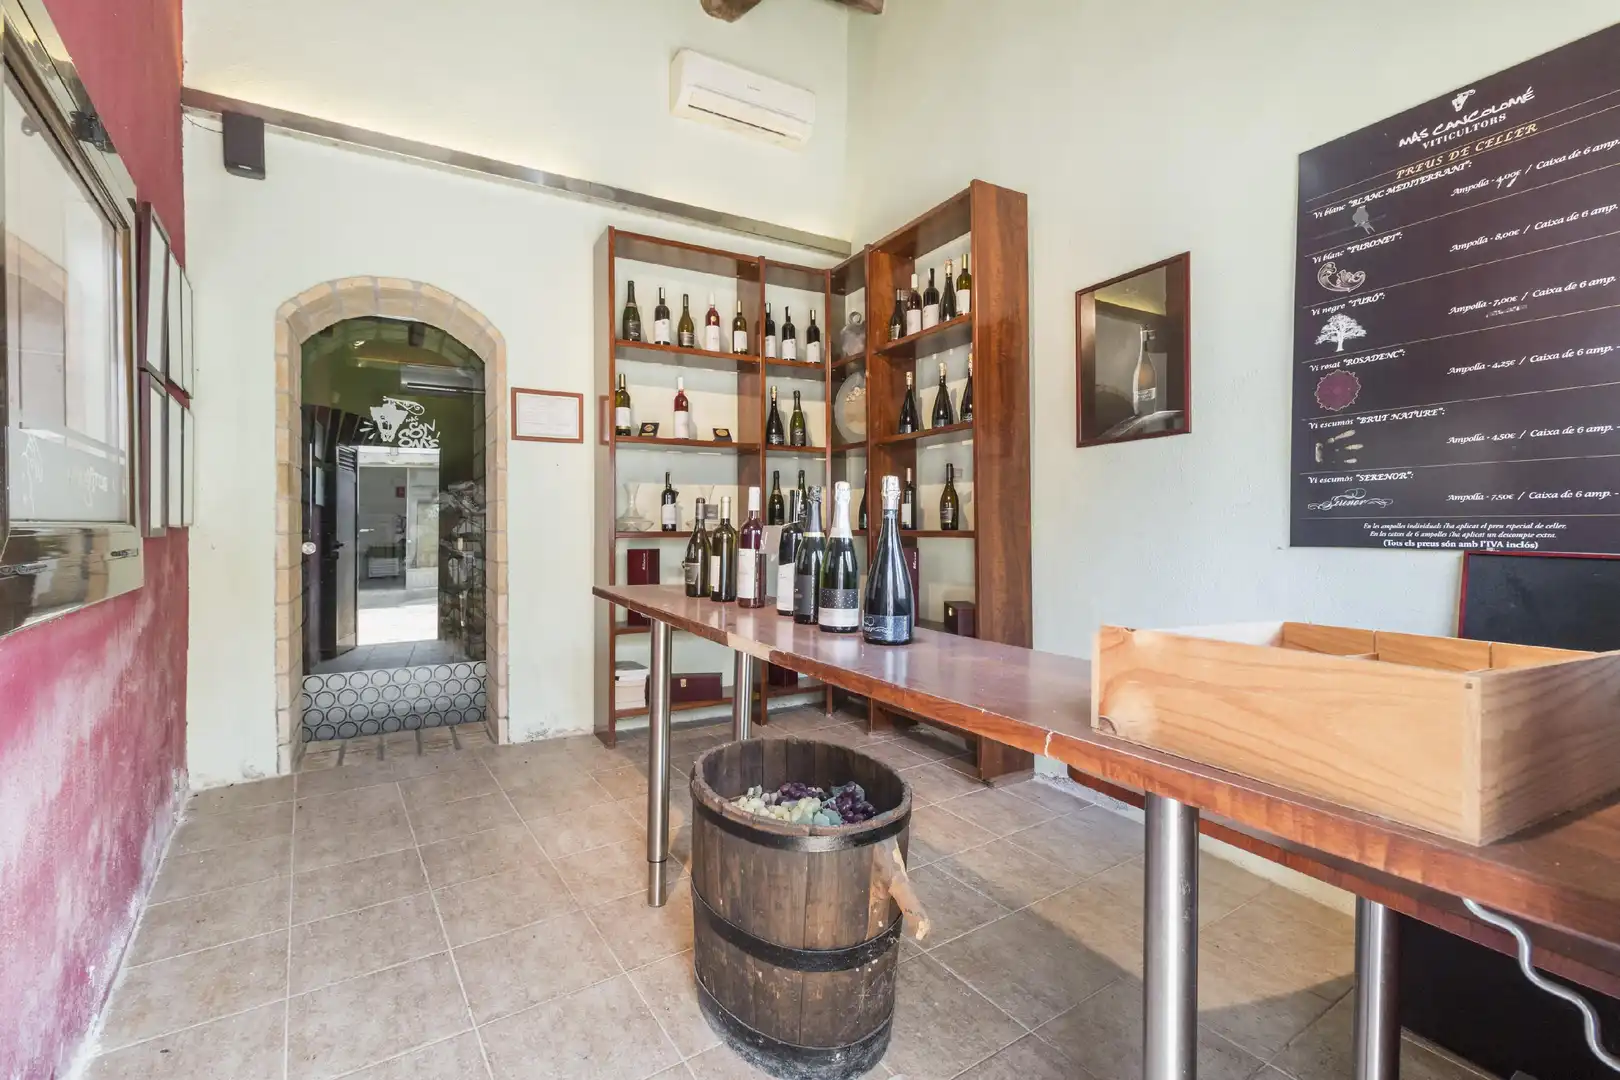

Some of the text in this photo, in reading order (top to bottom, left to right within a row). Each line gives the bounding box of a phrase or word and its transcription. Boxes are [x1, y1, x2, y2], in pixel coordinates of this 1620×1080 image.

[1398, 128, 1428, 148] MAS
[1422, 112, 1508, 149] VITICULTORS
[1396, 123, 1538, 179] PREUS DE CELLER
[1451, 178, 1489, 196] Ampolla
[1536, 156, 1566, 170] Caixa
[1568, 149, 1581, 160] de
[1583, 146, 1591, 155] 6
[1592, 140, 1620, 150] amp.
[1324, 204, 1346, 216] blanc
[1450, 235, 1488, 252] Ampolla
[1534, 217, 1564, 230] Caixa
[1566, 212, 1579, 221] de
[1581, 209, 1589, 217] 6
[1590, 203, 1618, 215] amp.
[1323, 250, 1344, 261] blanc
[1448, 300, 1487, 315] Ampolla
[1532, 286, 1562, 298] Caixa
[1564, 282, 1577, 291] de
[1579, 280, 1587, 289] 6
[1588, 275, 1616, 287] amp.
[1311, 308, 1320, 316] Vi
[1322, 304, 1346, 314] negre
[1320, 362, 1340, 370] rosat
[1447, 362, 1486, 374] Ampolla
[1529, 352, 1560, 362] Caixa
[1562, 349, 1574, 358] de
[1585, 344, 1614, 355] amp.
[1446, 433, 1485, 444] Ampolla
[1530, 428, 1560, 438] Caixa
[1562, 426, 1574, 434] de
[1586, 424, 1614, 434] amp.
[1446, 492, 1484, 502] Ampolla
[1529, 490, 1558, 499] Caixa
[1560, 490, 1573, 498] de
[1584, 490, 1612, 500] amp.
[1506, 522, 1534, 531] especial
